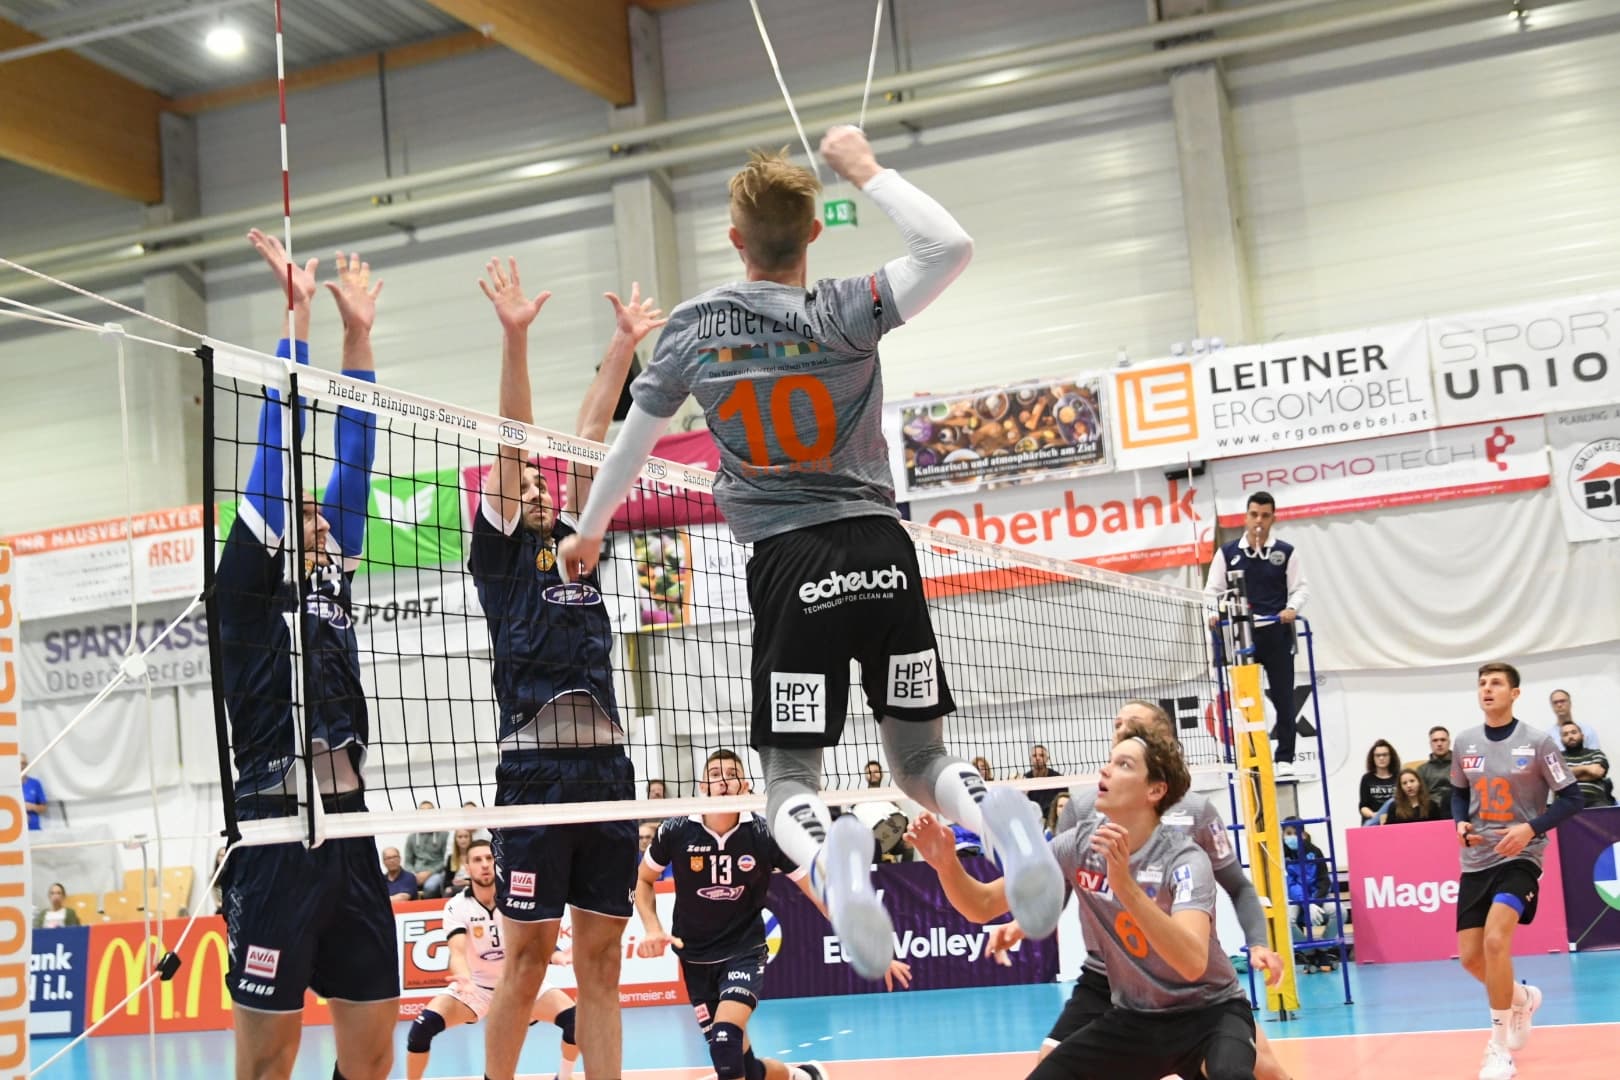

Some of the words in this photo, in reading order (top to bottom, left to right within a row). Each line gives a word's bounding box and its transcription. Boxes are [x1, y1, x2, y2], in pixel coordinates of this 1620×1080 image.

[1439, 307, 1620, 366] SPOR
[1209, 344, 1389, 394] LEITNER
[328, 379, 367, 403] Rieder
[371, 391, 477, 430] Reinigungs-Service
[717, 374, 838, 467] 10
[1212, 377, 1425, 430] ERGOMÖBEL
[1216, 409, 1429, 448] www.ergomoebel.at
[1241, 443, 1477, 491] PROMOTECH
[928, 489, 1201, 554] Oberbank
[799, 564, 908, 604] scheuch
[858, 592, 881, 600] CLEAN
[882, 591, 894, 599] AIR
[45, 614, 208, 664] SPARKASS
[896, 658, 933, 680] HPY
[776, 682, 819, 701] HPY
[894, 678, 933, 699] BET
[776, 703, 819, 722] BET
[1475, 776, 1513, 812] 13
[709, 855, 732, 885] 13
[506, 897, 536, 910] Zeus
[250, 951, 275, 963] AVIA
[238, 978, 275, 996] Zeus
